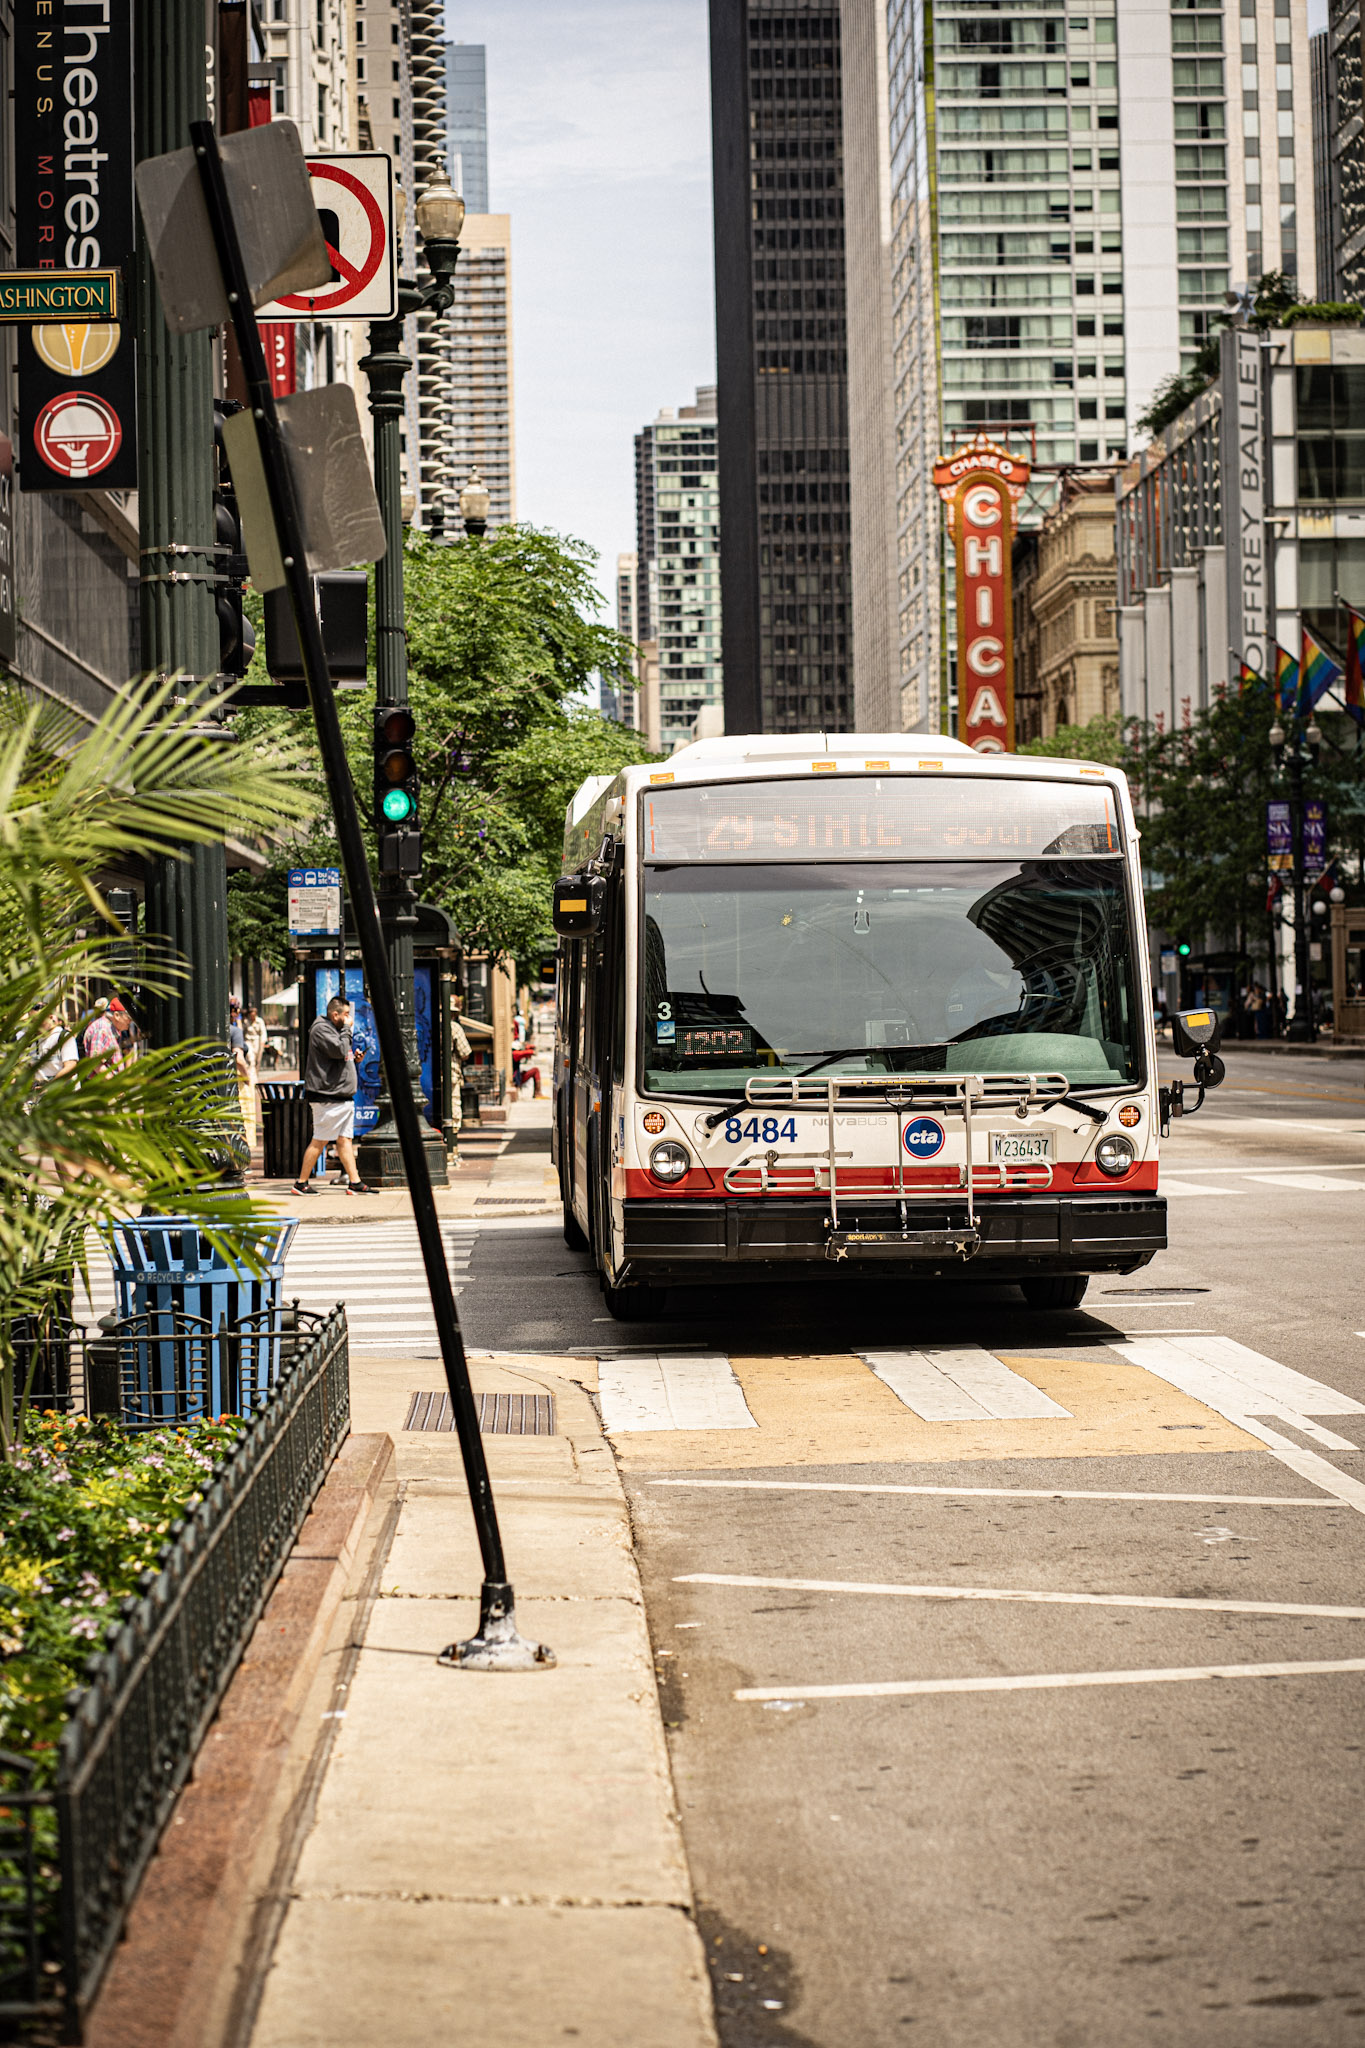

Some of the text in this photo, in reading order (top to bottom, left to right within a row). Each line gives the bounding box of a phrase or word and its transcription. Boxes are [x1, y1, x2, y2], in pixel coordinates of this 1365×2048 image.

[38, 155, 54, 268] MORE
[1238, 334, 1260, 491] BALLET
[657, 1002, 672, 1020] 3
[725, 1117, 798, 1144] 8484
[147, 1272, 182, 1284] RECYCLE
